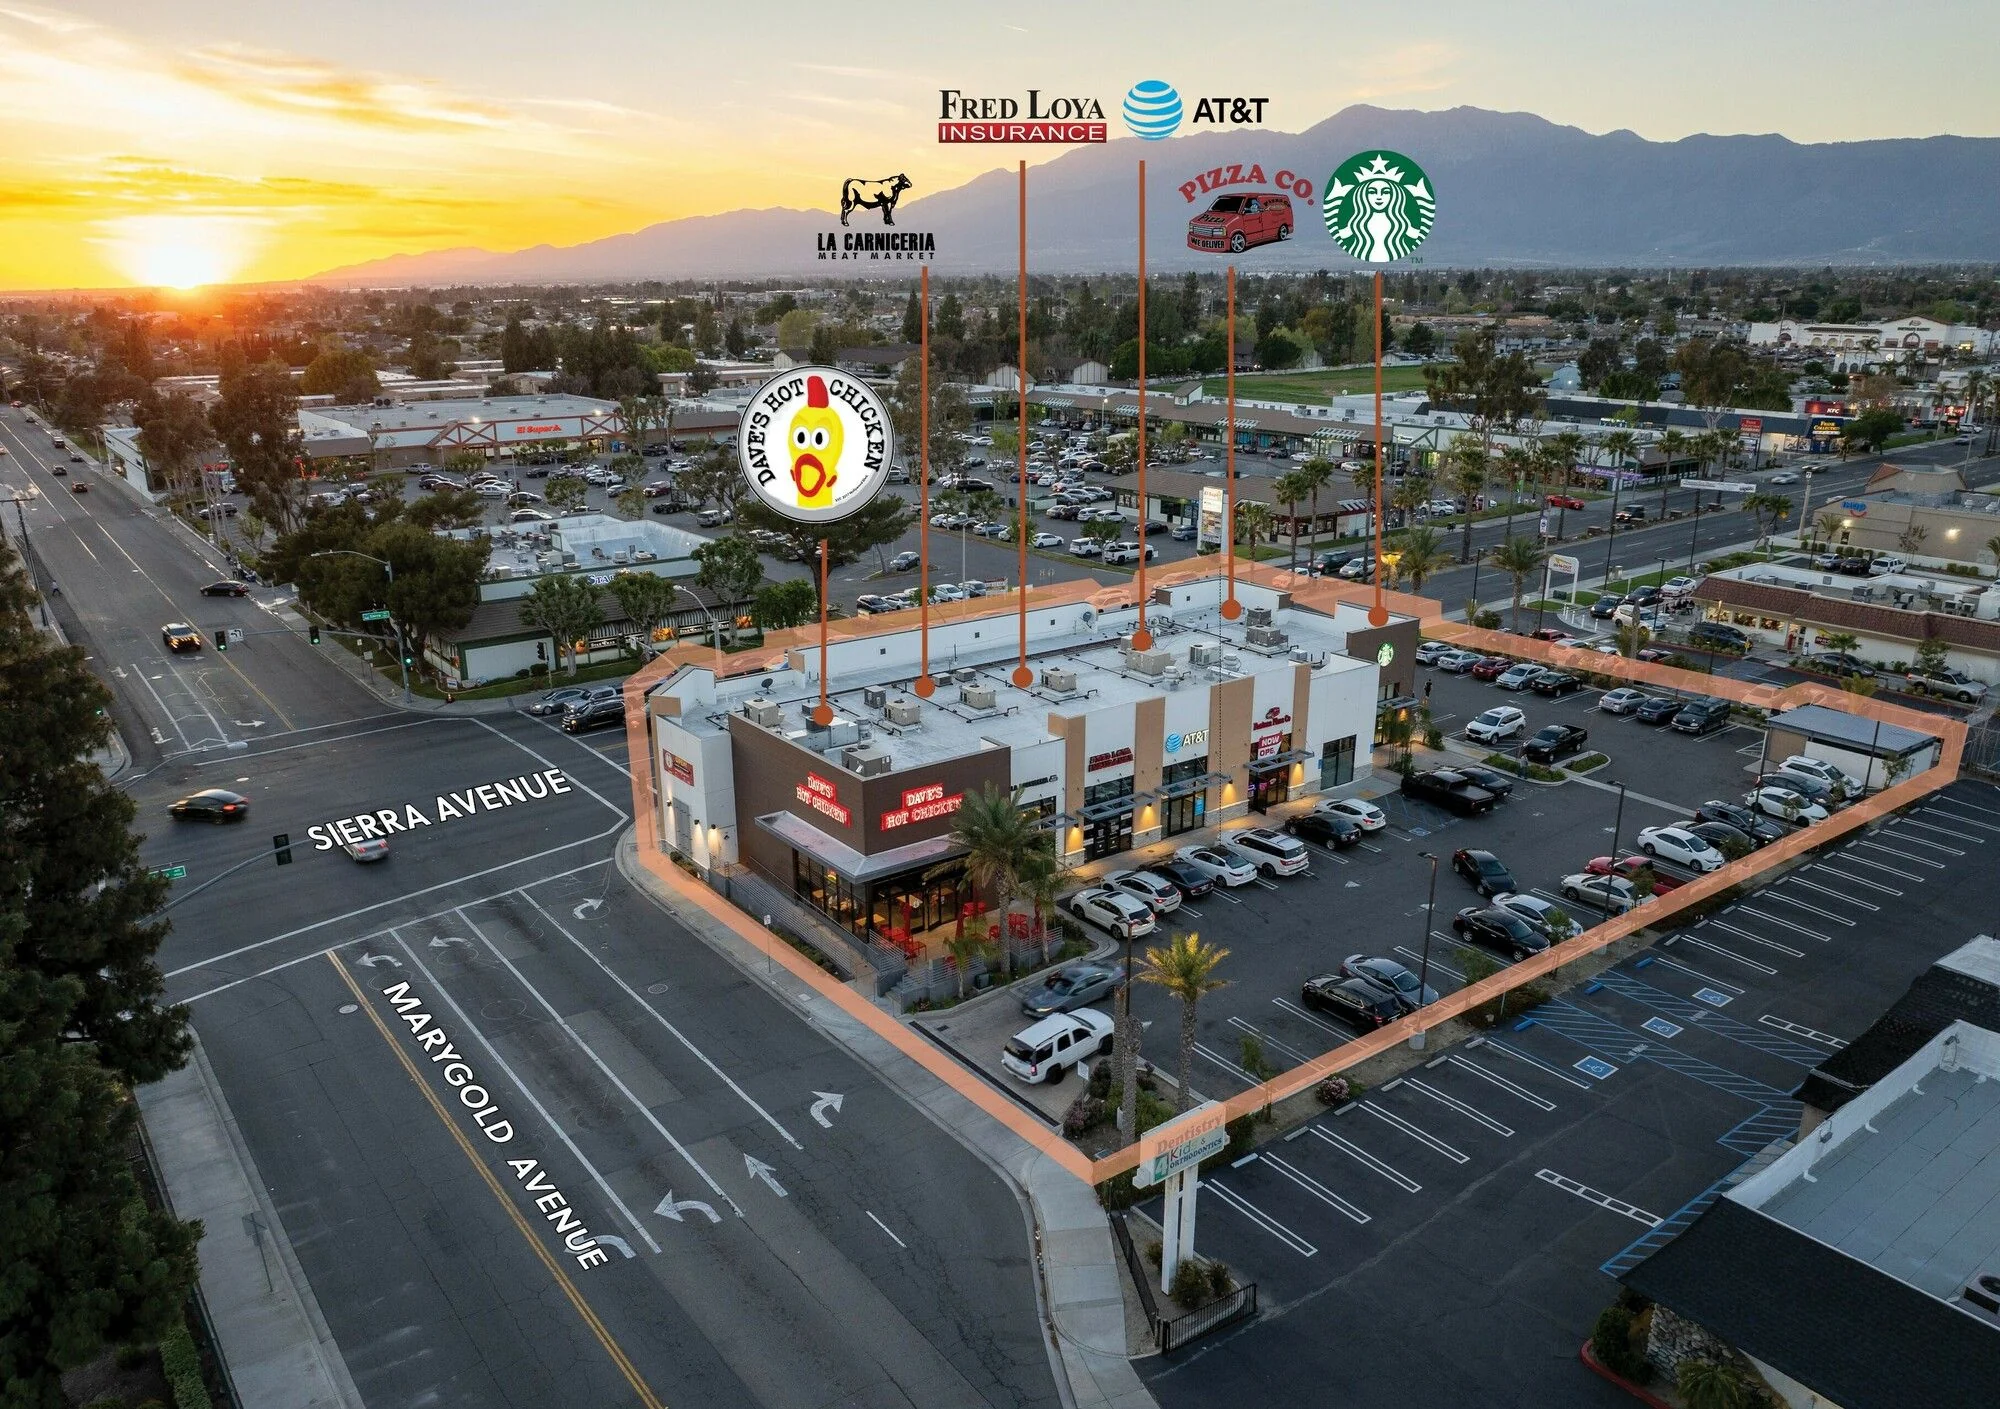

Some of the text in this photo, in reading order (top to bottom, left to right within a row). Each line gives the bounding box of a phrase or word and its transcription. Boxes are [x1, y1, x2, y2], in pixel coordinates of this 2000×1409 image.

[1826, 407, 1840, 415] KFC
[1181, 729, 1210, 747] AT&T
[1261, 735, 1280, 747] NOW
[1259, 747, 1275, 757] OPE
[807, 776, 833, 799] DAVE'S
[906, 786, 944, 807] DAVE'S
[796, 786, 848, 824] HOT CHICKEN
[886, 798, 963, 829] HOT CHICKEN
[1156, 1113, 1223, 1154] Dentistry
[1169, 1138, 1223, 1169] ORTHODONTICS
